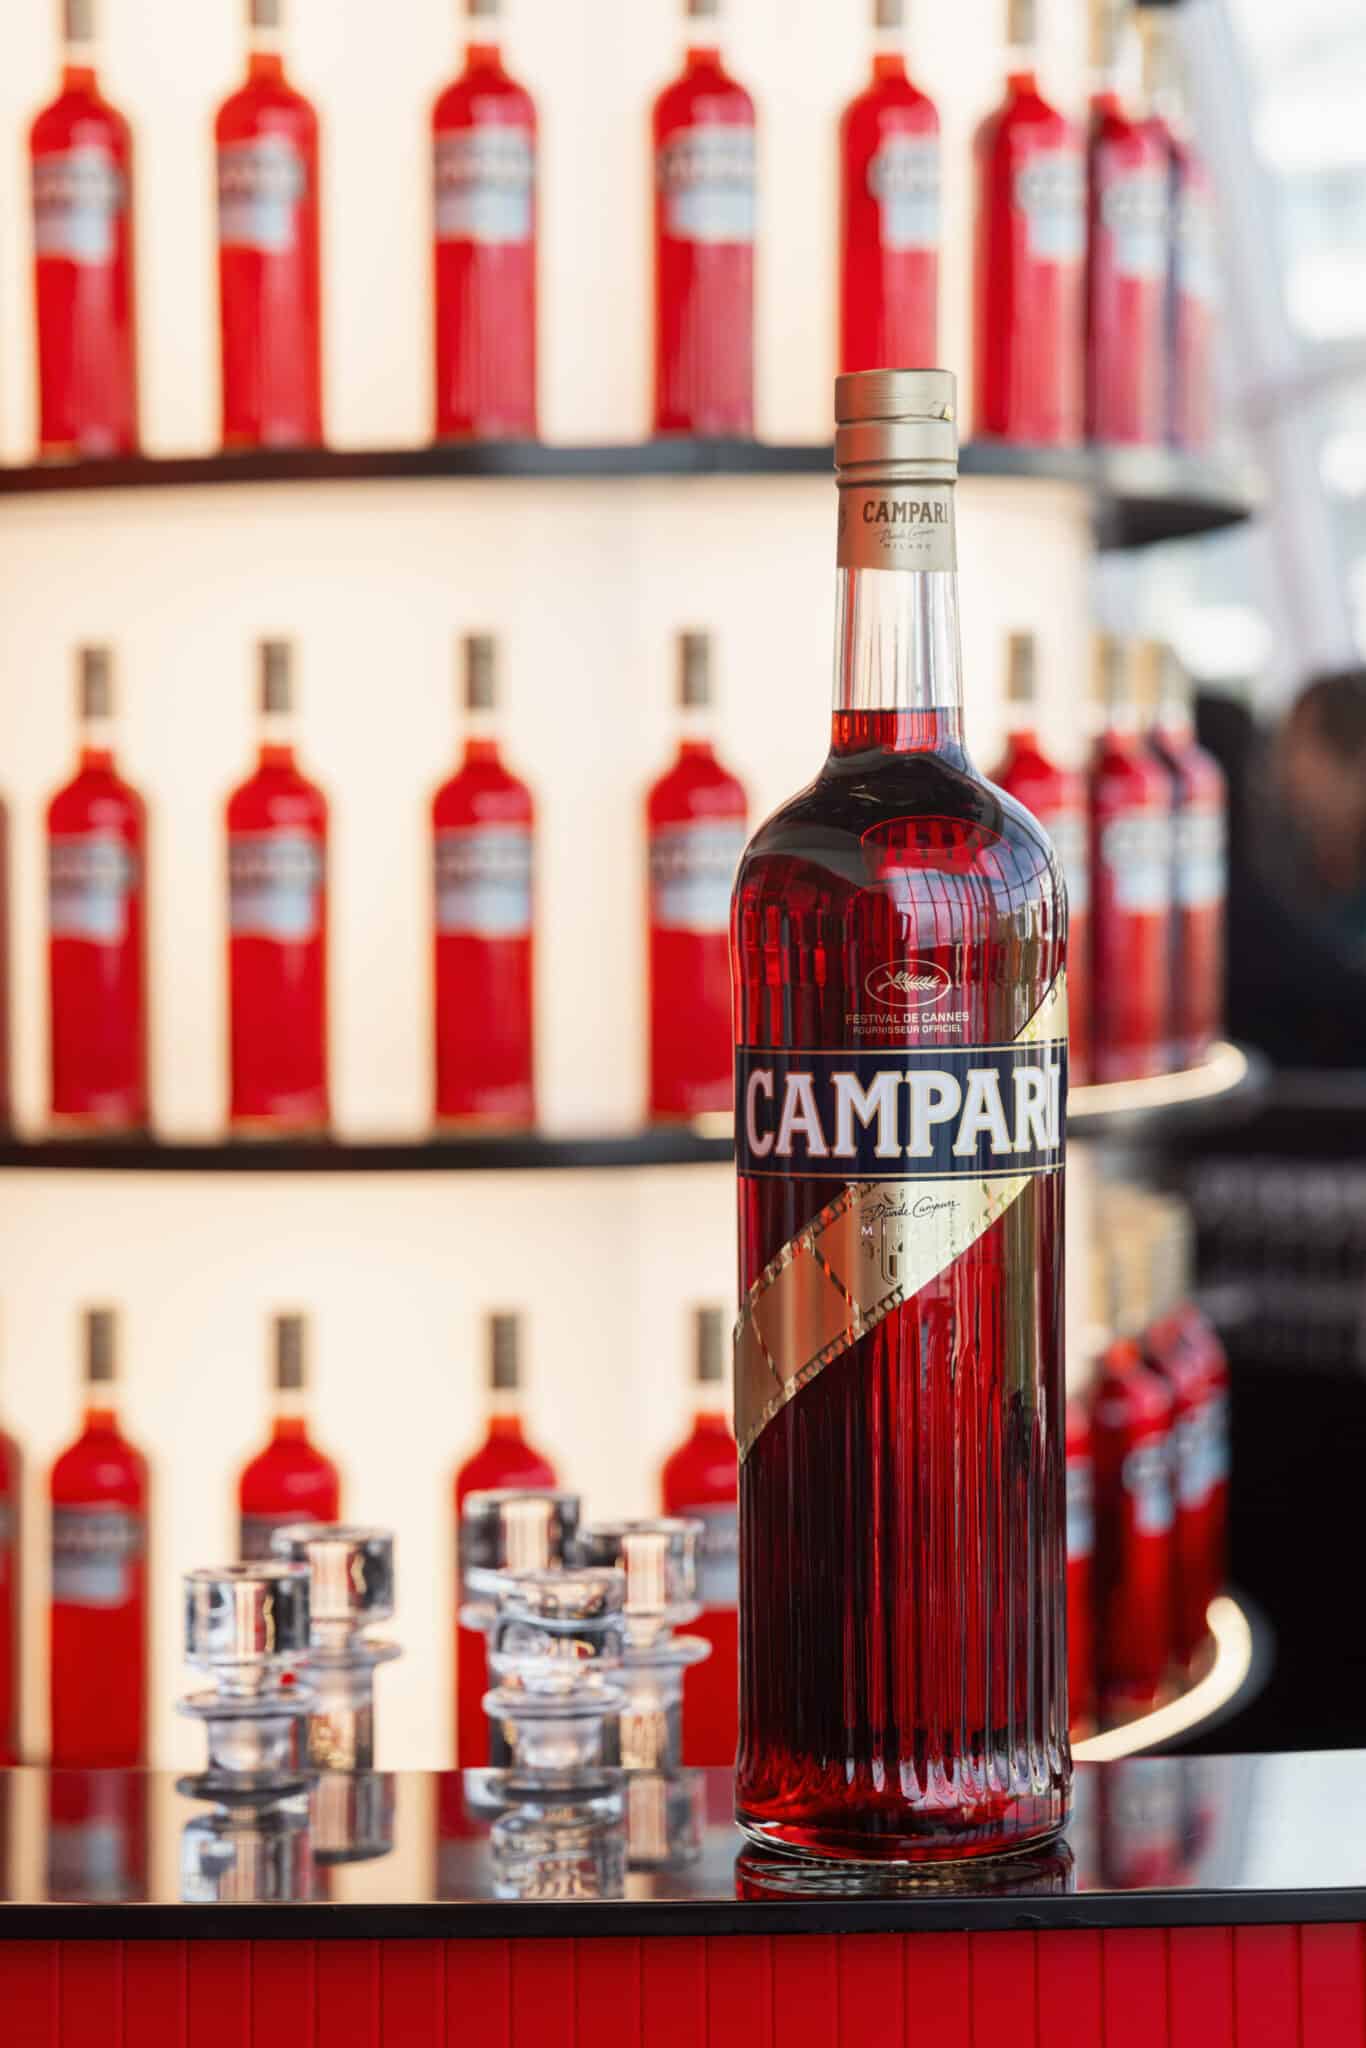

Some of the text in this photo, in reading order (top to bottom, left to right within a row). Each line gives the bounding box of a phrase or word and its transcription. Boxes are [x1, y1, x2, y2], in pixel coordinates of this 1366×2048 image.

[863, 501, 949, 523] CAMPARI
[845, 1011, 969, 1024] FESTIVAL DE CANNES
[853, 1023, 962, 1035] FOURNISSEUR OFFICIEL
[746, 1065, 1061, 1159] CAMPARI
